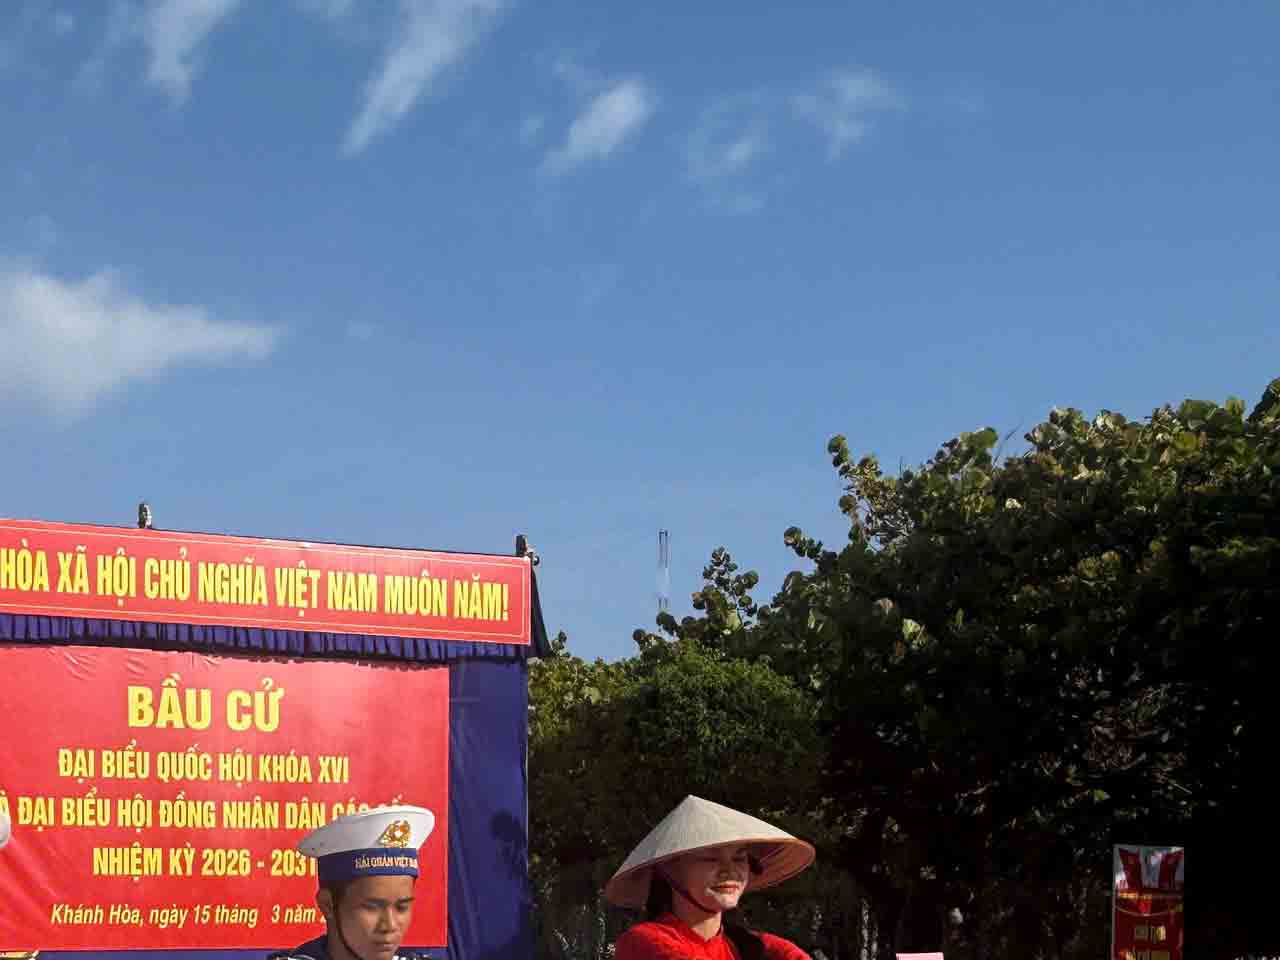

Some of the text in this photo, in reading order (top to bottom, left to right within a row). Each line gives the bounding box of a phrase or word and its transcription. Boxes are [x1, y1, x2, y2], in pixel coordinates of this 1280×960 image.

[0, 539, 50, 592] HÒA
[57, 545, 89, 595] XÃ
[96, 547, 136, 606] HỘI
[144, 547, 190, 601] CHỦ
[198, 556, 268, 606] NGHĨA
[275, 560, 320, 616] VIỆT
[327, 570, 377, 612] NAM
[384, 569, 447, 616] MUÔN
[453, 572, 509, 621] NĂM!
[127, 673, 285, 732] BẦU CỬ
[58, 739, 349, 788] ĐẠI BIỂU QUỐC HỘI KHÓA XVI
[17, 796, 55, 832] ĐẠI
[62, 786, 111, 826] BIỂU
[117, 793, 152, 832] HỘI
[158, 791, 216, 828] ĐỒNG
[223, 795, 279, 828] NHÂN
[285, 796, 326, 829] DÂN
[93, 842, 162, 881] NHIỆM
[169, 842, 195, 876] KỲ
[201, 849, 251, 876] 2026
[50, 903, 104, 925] Khánh
[109, 904, 144, 927] Hòa,
[149, 906, 188, 928] ngày
[193, 904, 210, 924] 15
[214, 904, 258, 928] tháng
[271, 905, 280, 924] 3
[284, 905, 316, 925] năm
